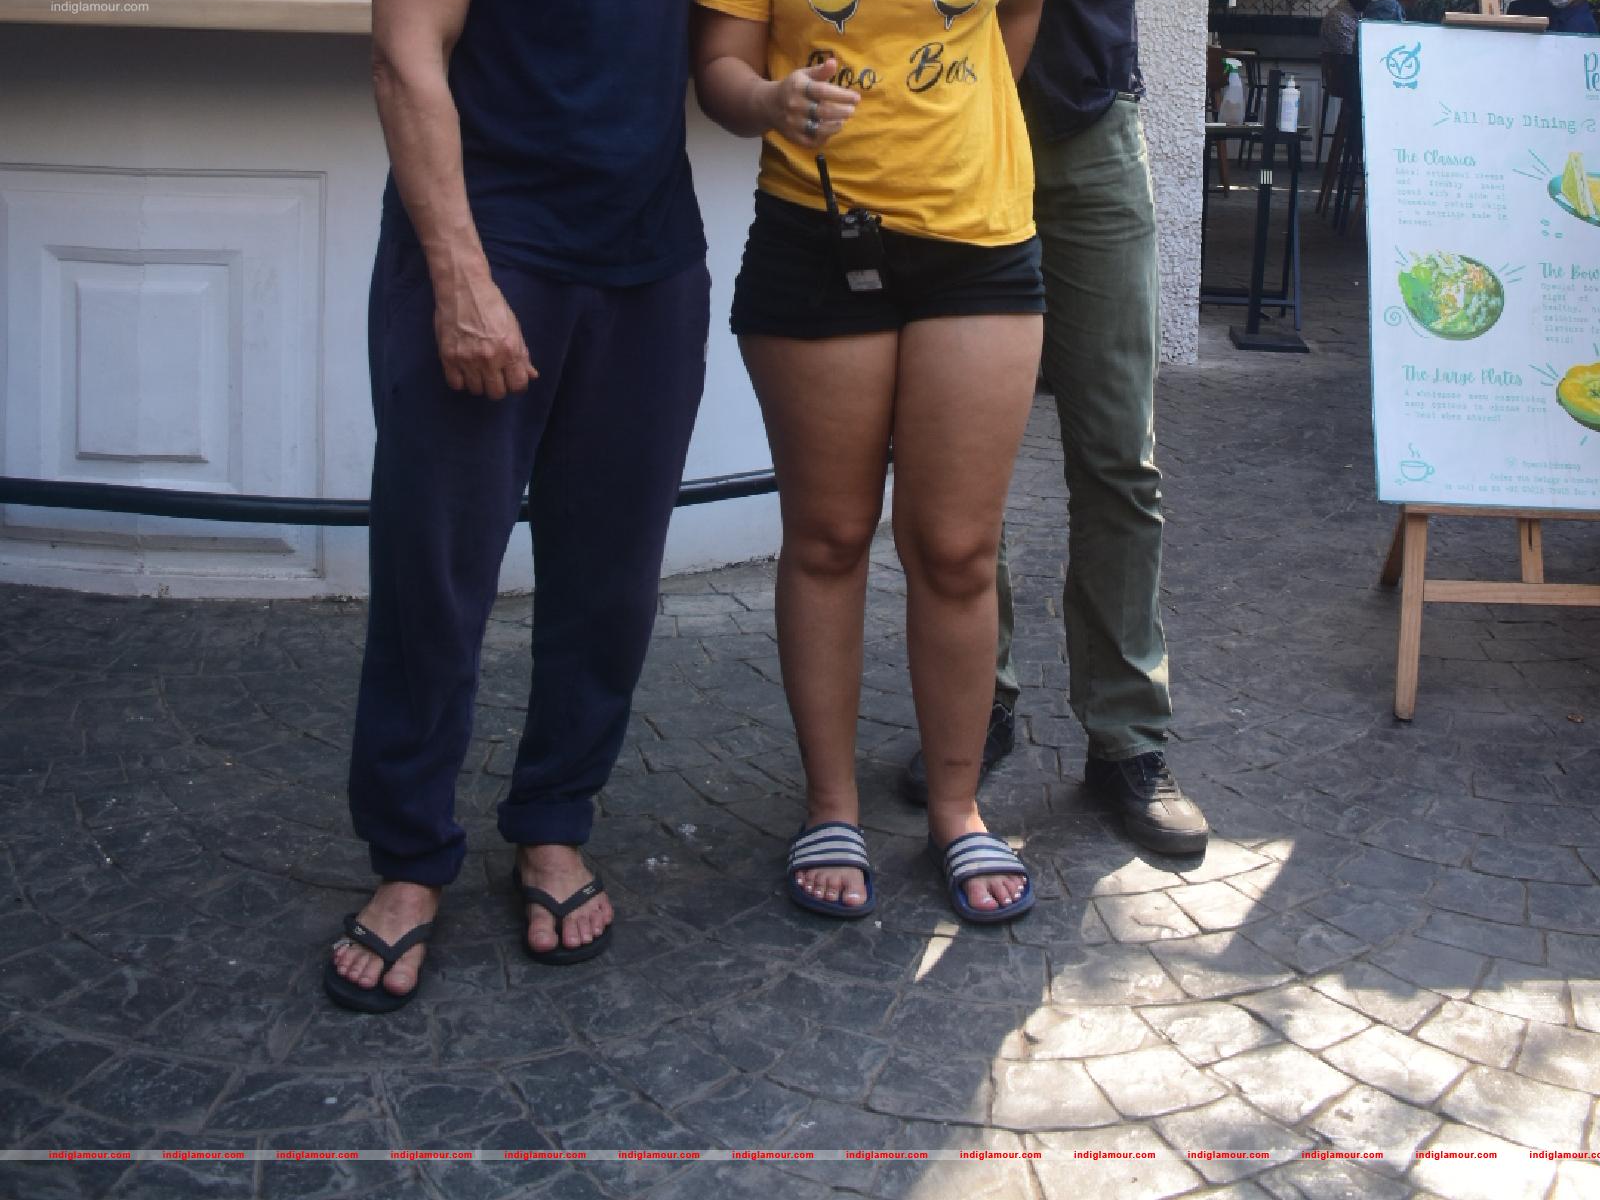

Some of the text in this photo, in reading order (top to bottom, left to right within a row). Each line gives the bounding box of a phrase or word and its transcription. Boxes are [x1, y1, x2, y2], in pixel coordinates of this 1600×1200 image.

[1454, 111, 1576, 135] All Day Dining
[1393, 148, 1476, 167] The Classics
[1537, 262, 1600, 281] The Bow
[1402, 364, 1523, 387] The Large Plates
